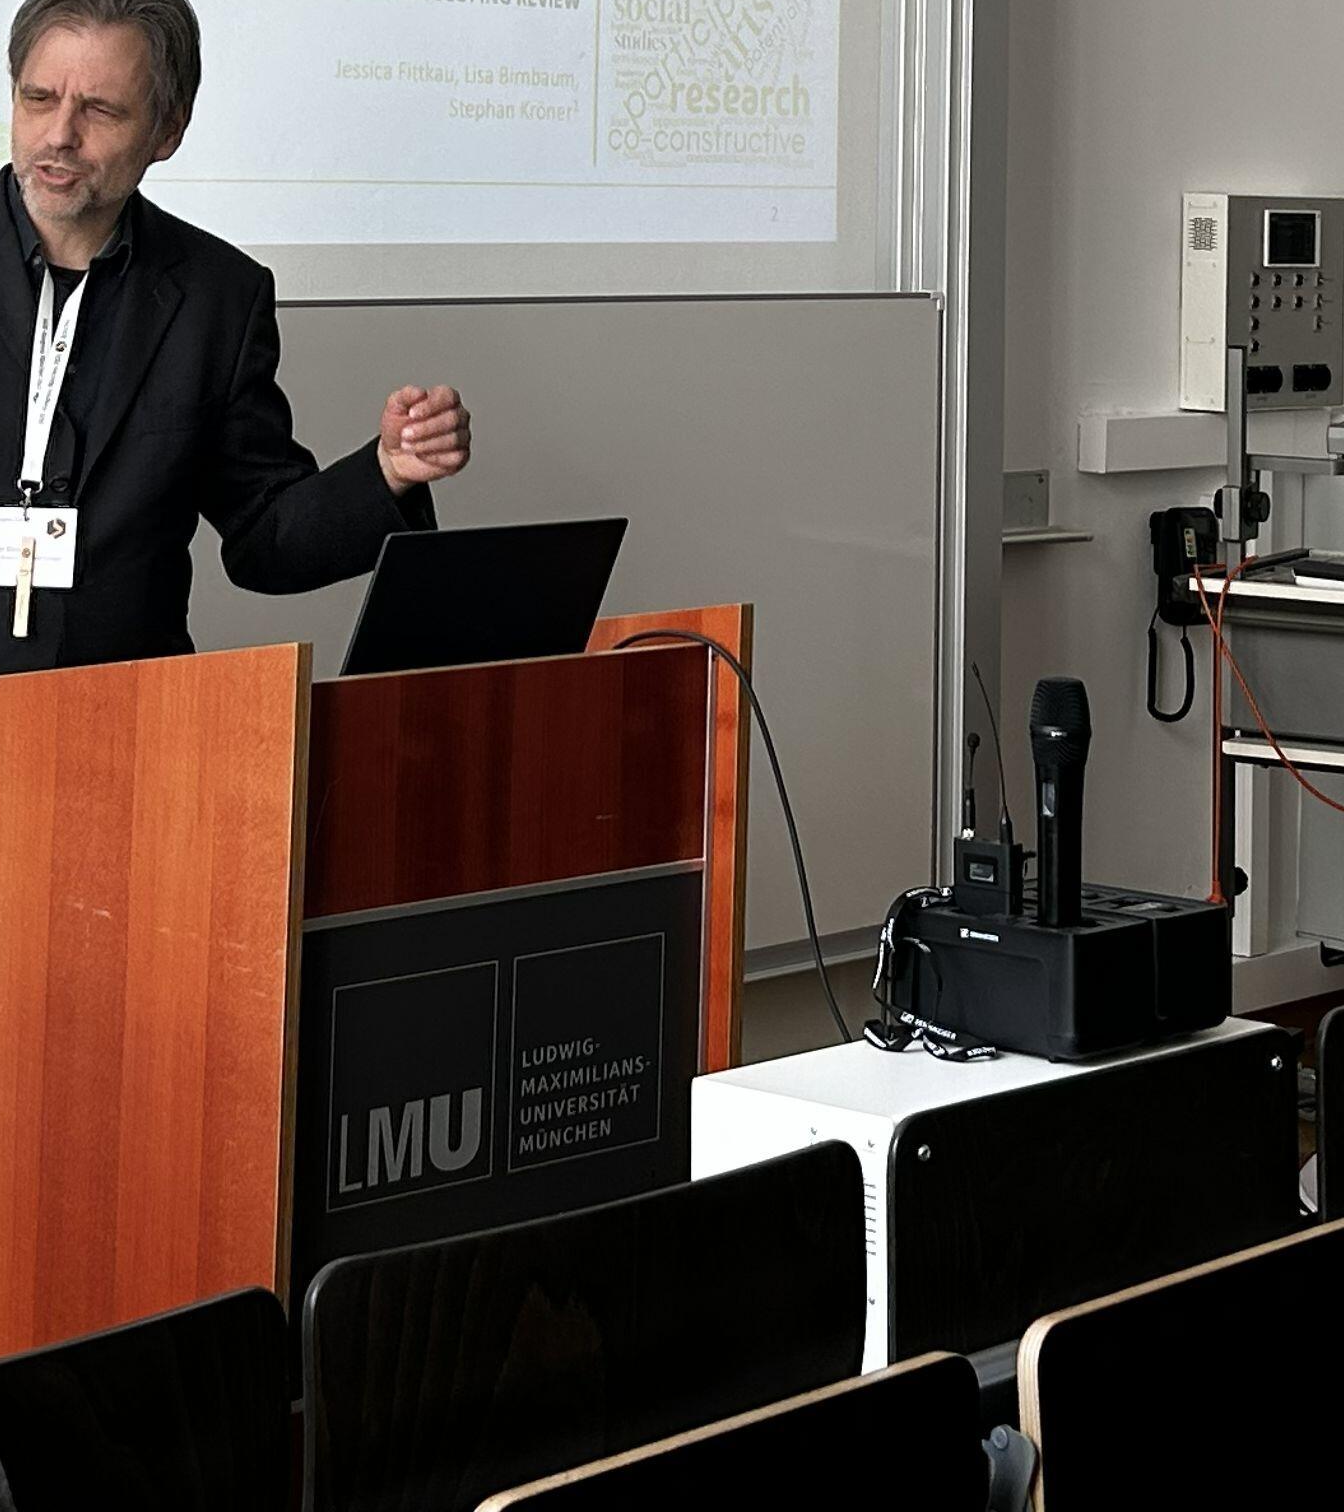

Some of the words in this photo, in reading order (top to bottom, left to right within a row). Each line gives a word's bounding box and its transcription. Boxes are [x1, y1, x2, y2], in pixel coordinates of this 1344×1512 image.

[671, 73, 811, 117] research
[607, 126, 806, 155] co-constructive
[521, 1037, 601, 1069] LUDWIG-
[520, 1055, 652, 1098] MAXIMILIANS-
[519, 1082, 642, 1125] UNIVERSITÄT
[338, 1087, 484, 1194] LMU
[518, 1117, 613, 1155] MÜNCHEN
